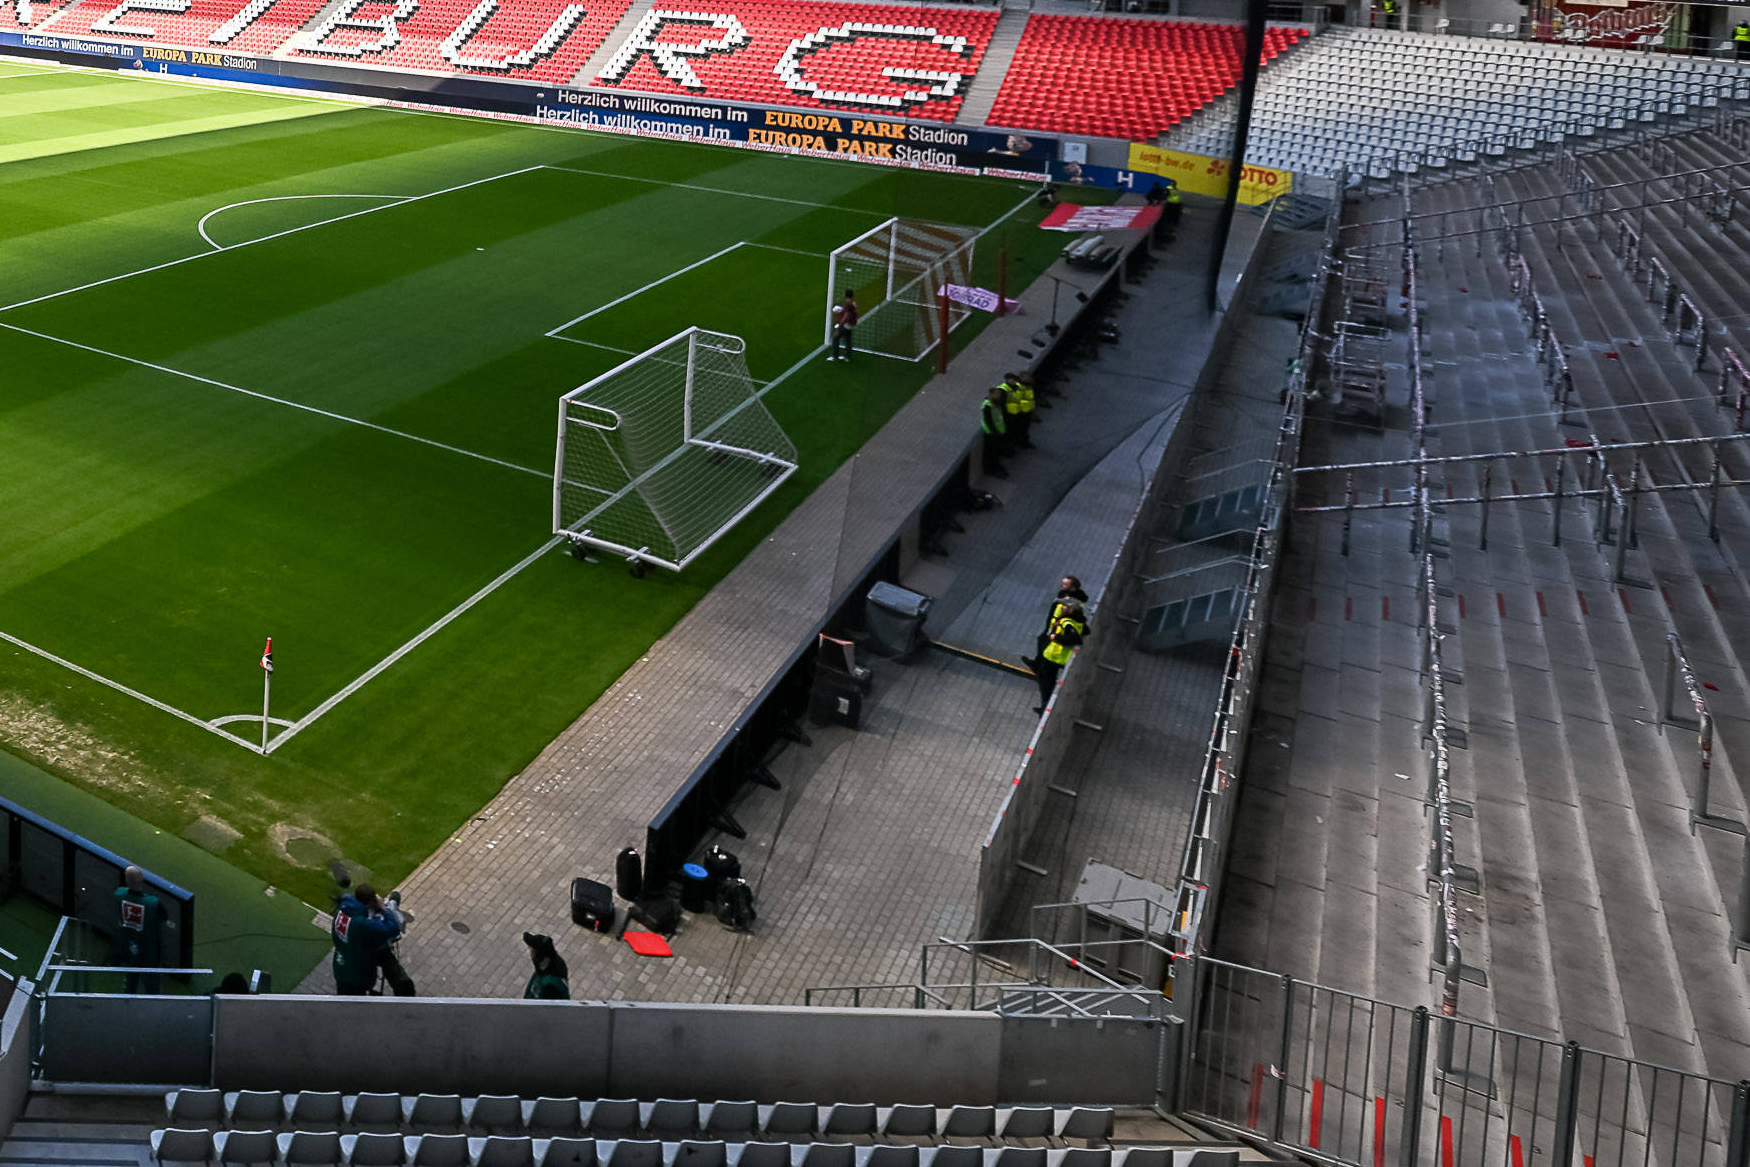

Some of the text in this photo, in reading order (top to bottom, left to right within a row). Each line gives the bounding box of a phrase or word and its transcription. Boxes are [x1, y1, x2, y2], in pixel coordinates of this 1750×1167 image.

[22, 34, 257, 70] Herzlich willkommen im EUROPA PARK Stadion
[536, 105, 957, 167] Herzlich willkommen im EUROPA PARK Stadion
[558, 89, 968, 147] Herzlich willkommen im EUROPA PARK Stadion
[1239, 167, 1278, 187] OTTO
